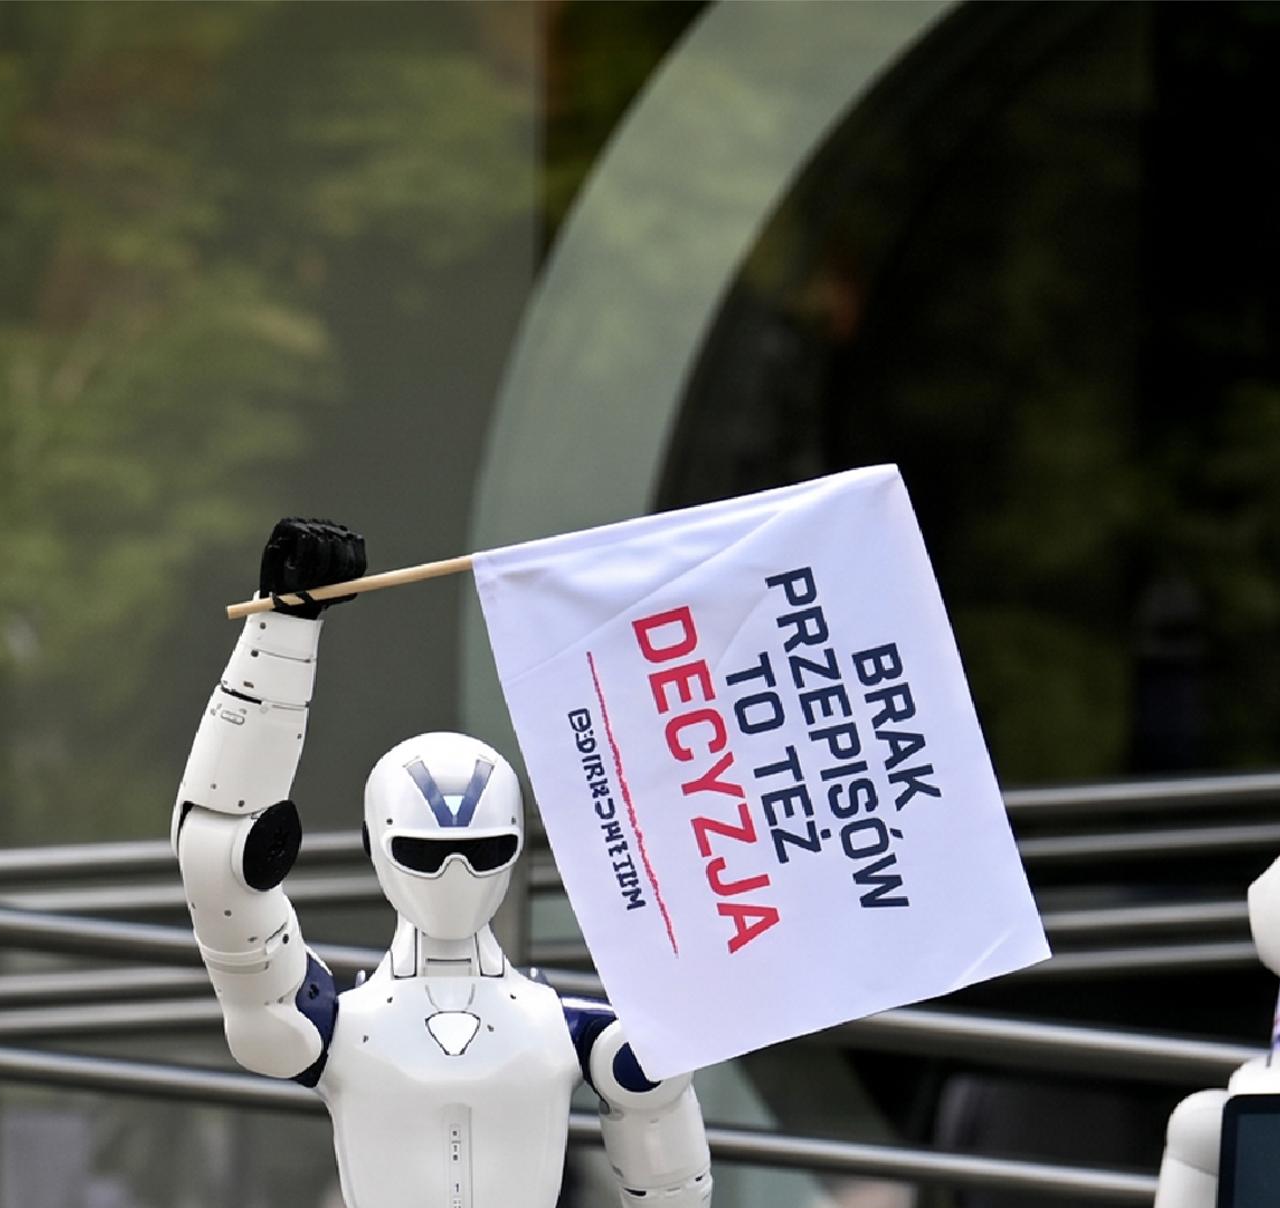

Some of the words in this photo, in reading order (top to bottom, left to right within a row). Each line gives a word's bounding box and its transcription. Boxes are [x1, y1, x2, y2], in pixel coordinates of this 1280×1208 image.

[631, 606, 781, 955] DECYZJA
[725, 651, 786, 736] TO
[760, 782, 833, 865] TEŻ
[764, 566, 911, 909] PRZEPISÓW
[851, 642, 943, 813] BRAK
